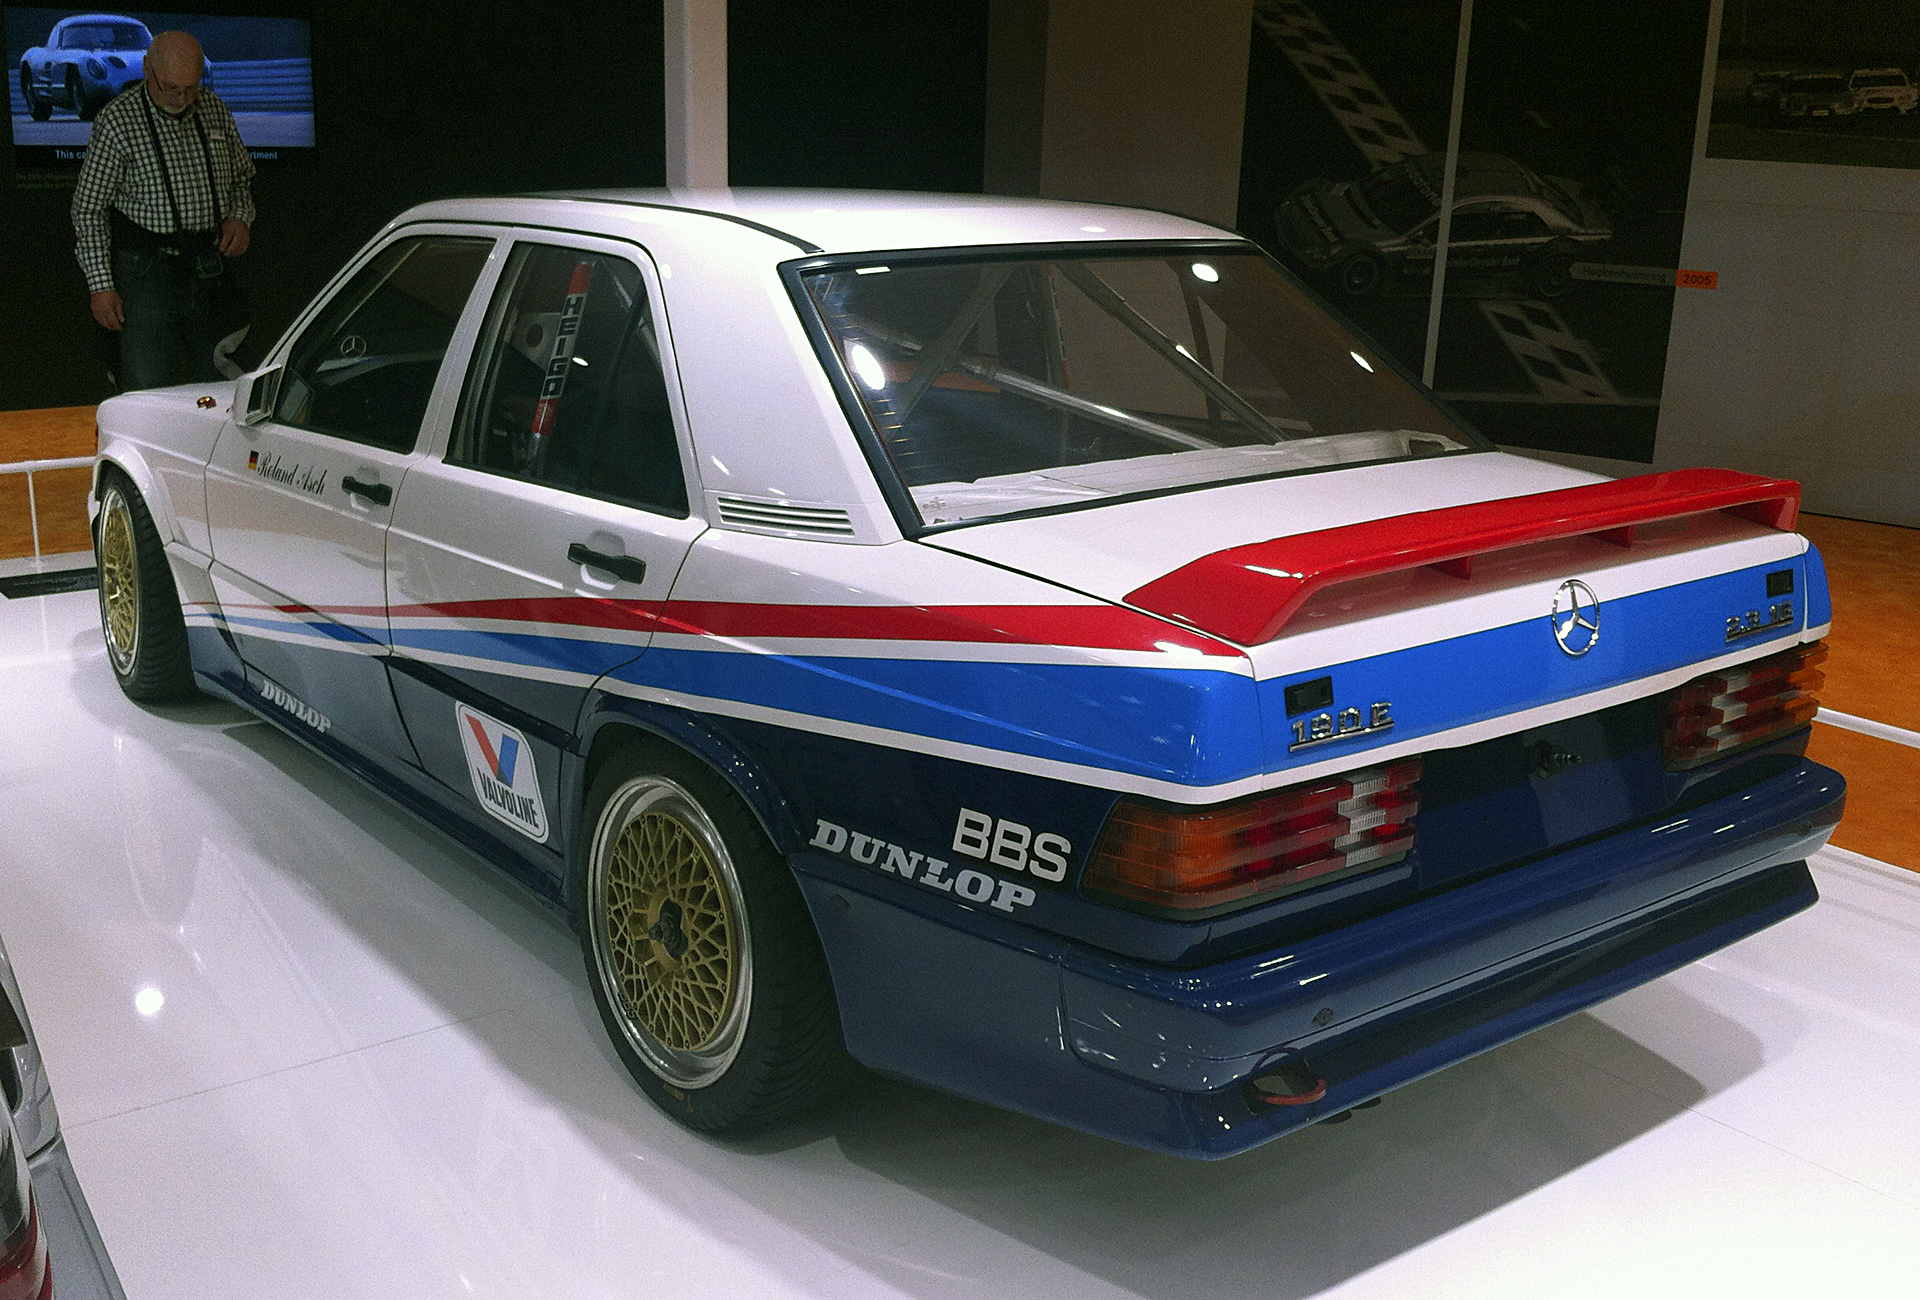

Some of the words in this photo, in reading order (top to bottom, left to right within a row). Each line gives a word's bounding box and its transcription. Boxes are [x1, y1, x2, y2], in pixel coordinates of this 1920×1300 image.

[55, 149, 75, 160] This
[1683, 274, 1712, 286] 2005
[541, 294, 584, 399] HEIGO
[257, 452, 299, 486] Roland
[296, 466, 328, 495] Asch
[261, 679, 332, 733] DUNLOP
[477, 767, 540, 829] VALVOLINE
[809, 818, 1036, 913] DUNLOP
[952, 807, 1071, 882] BBS
